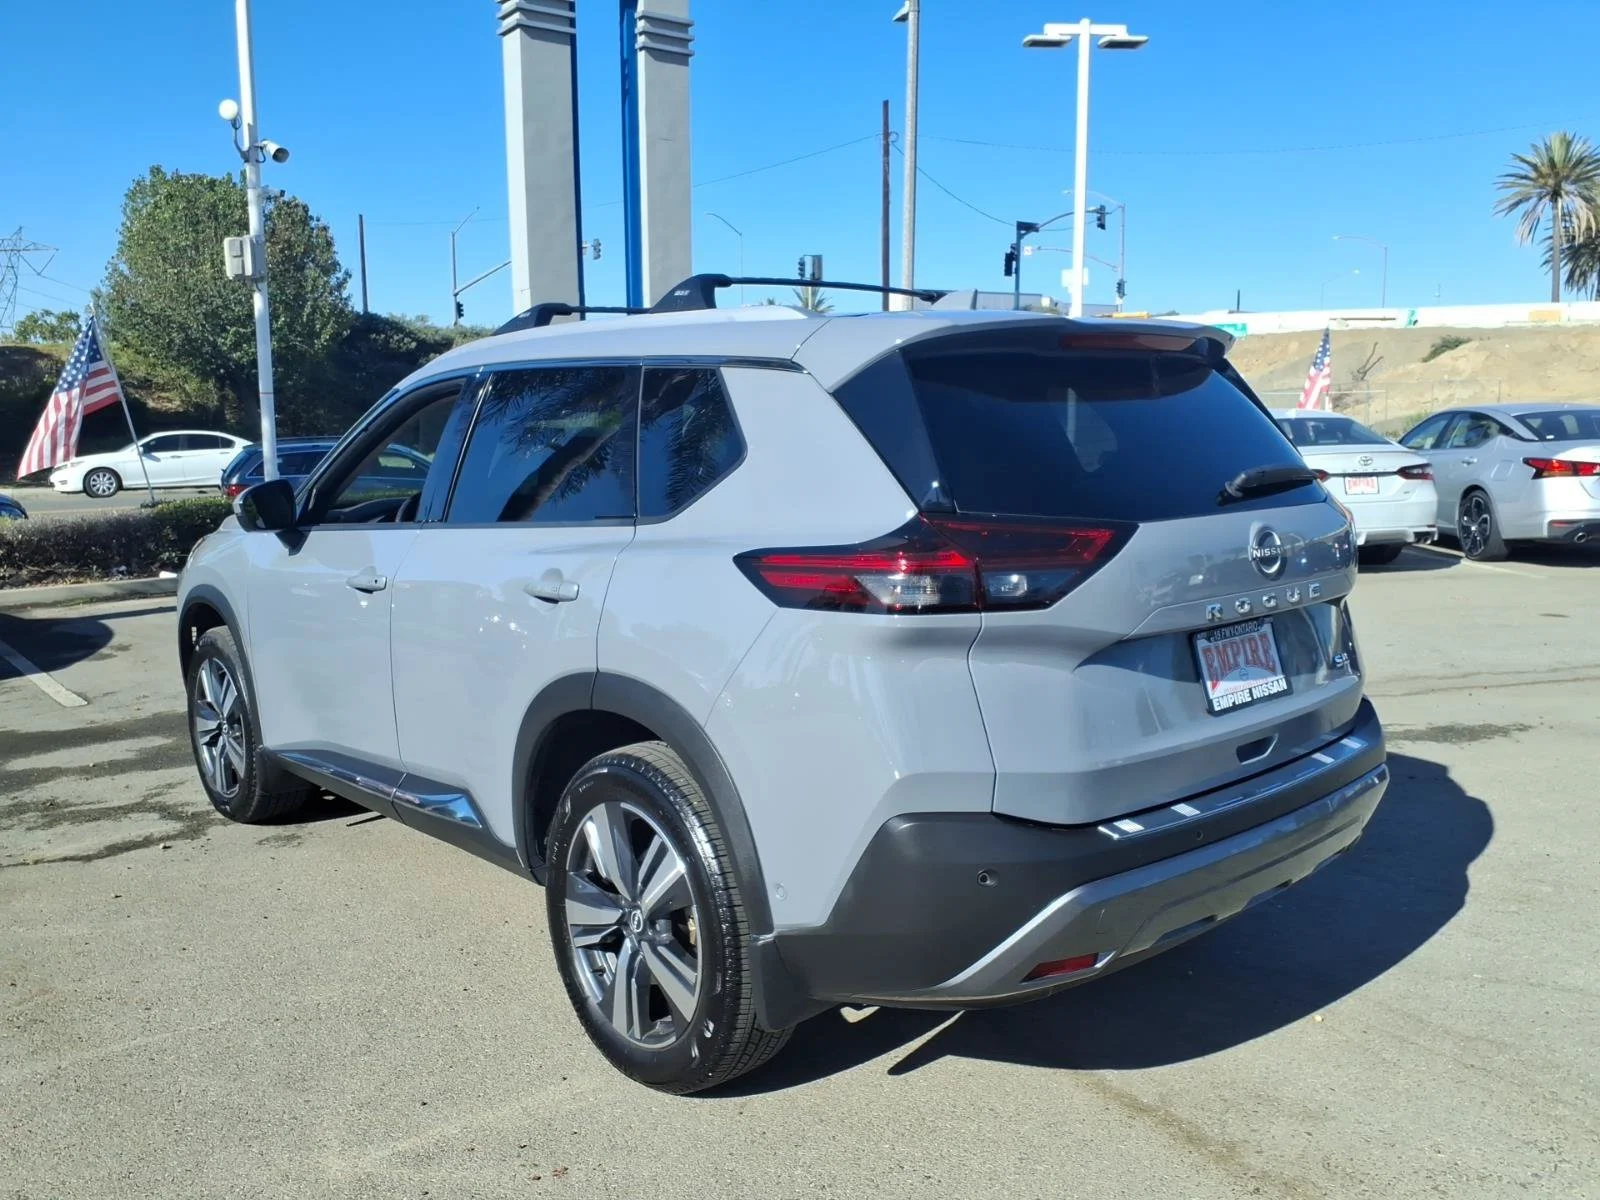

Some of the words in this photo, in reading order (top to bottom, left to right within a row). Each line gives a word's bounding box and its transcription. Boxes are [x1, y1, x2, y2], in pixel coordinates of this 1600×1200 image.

[1206, 582, 1321, 620] ROGUE
[1202, 633, 1278, 691] EMPIRE
[1213, 688, 1252, 711] EMPIRE
[1251, 677, 1288, 700] NISSAN
